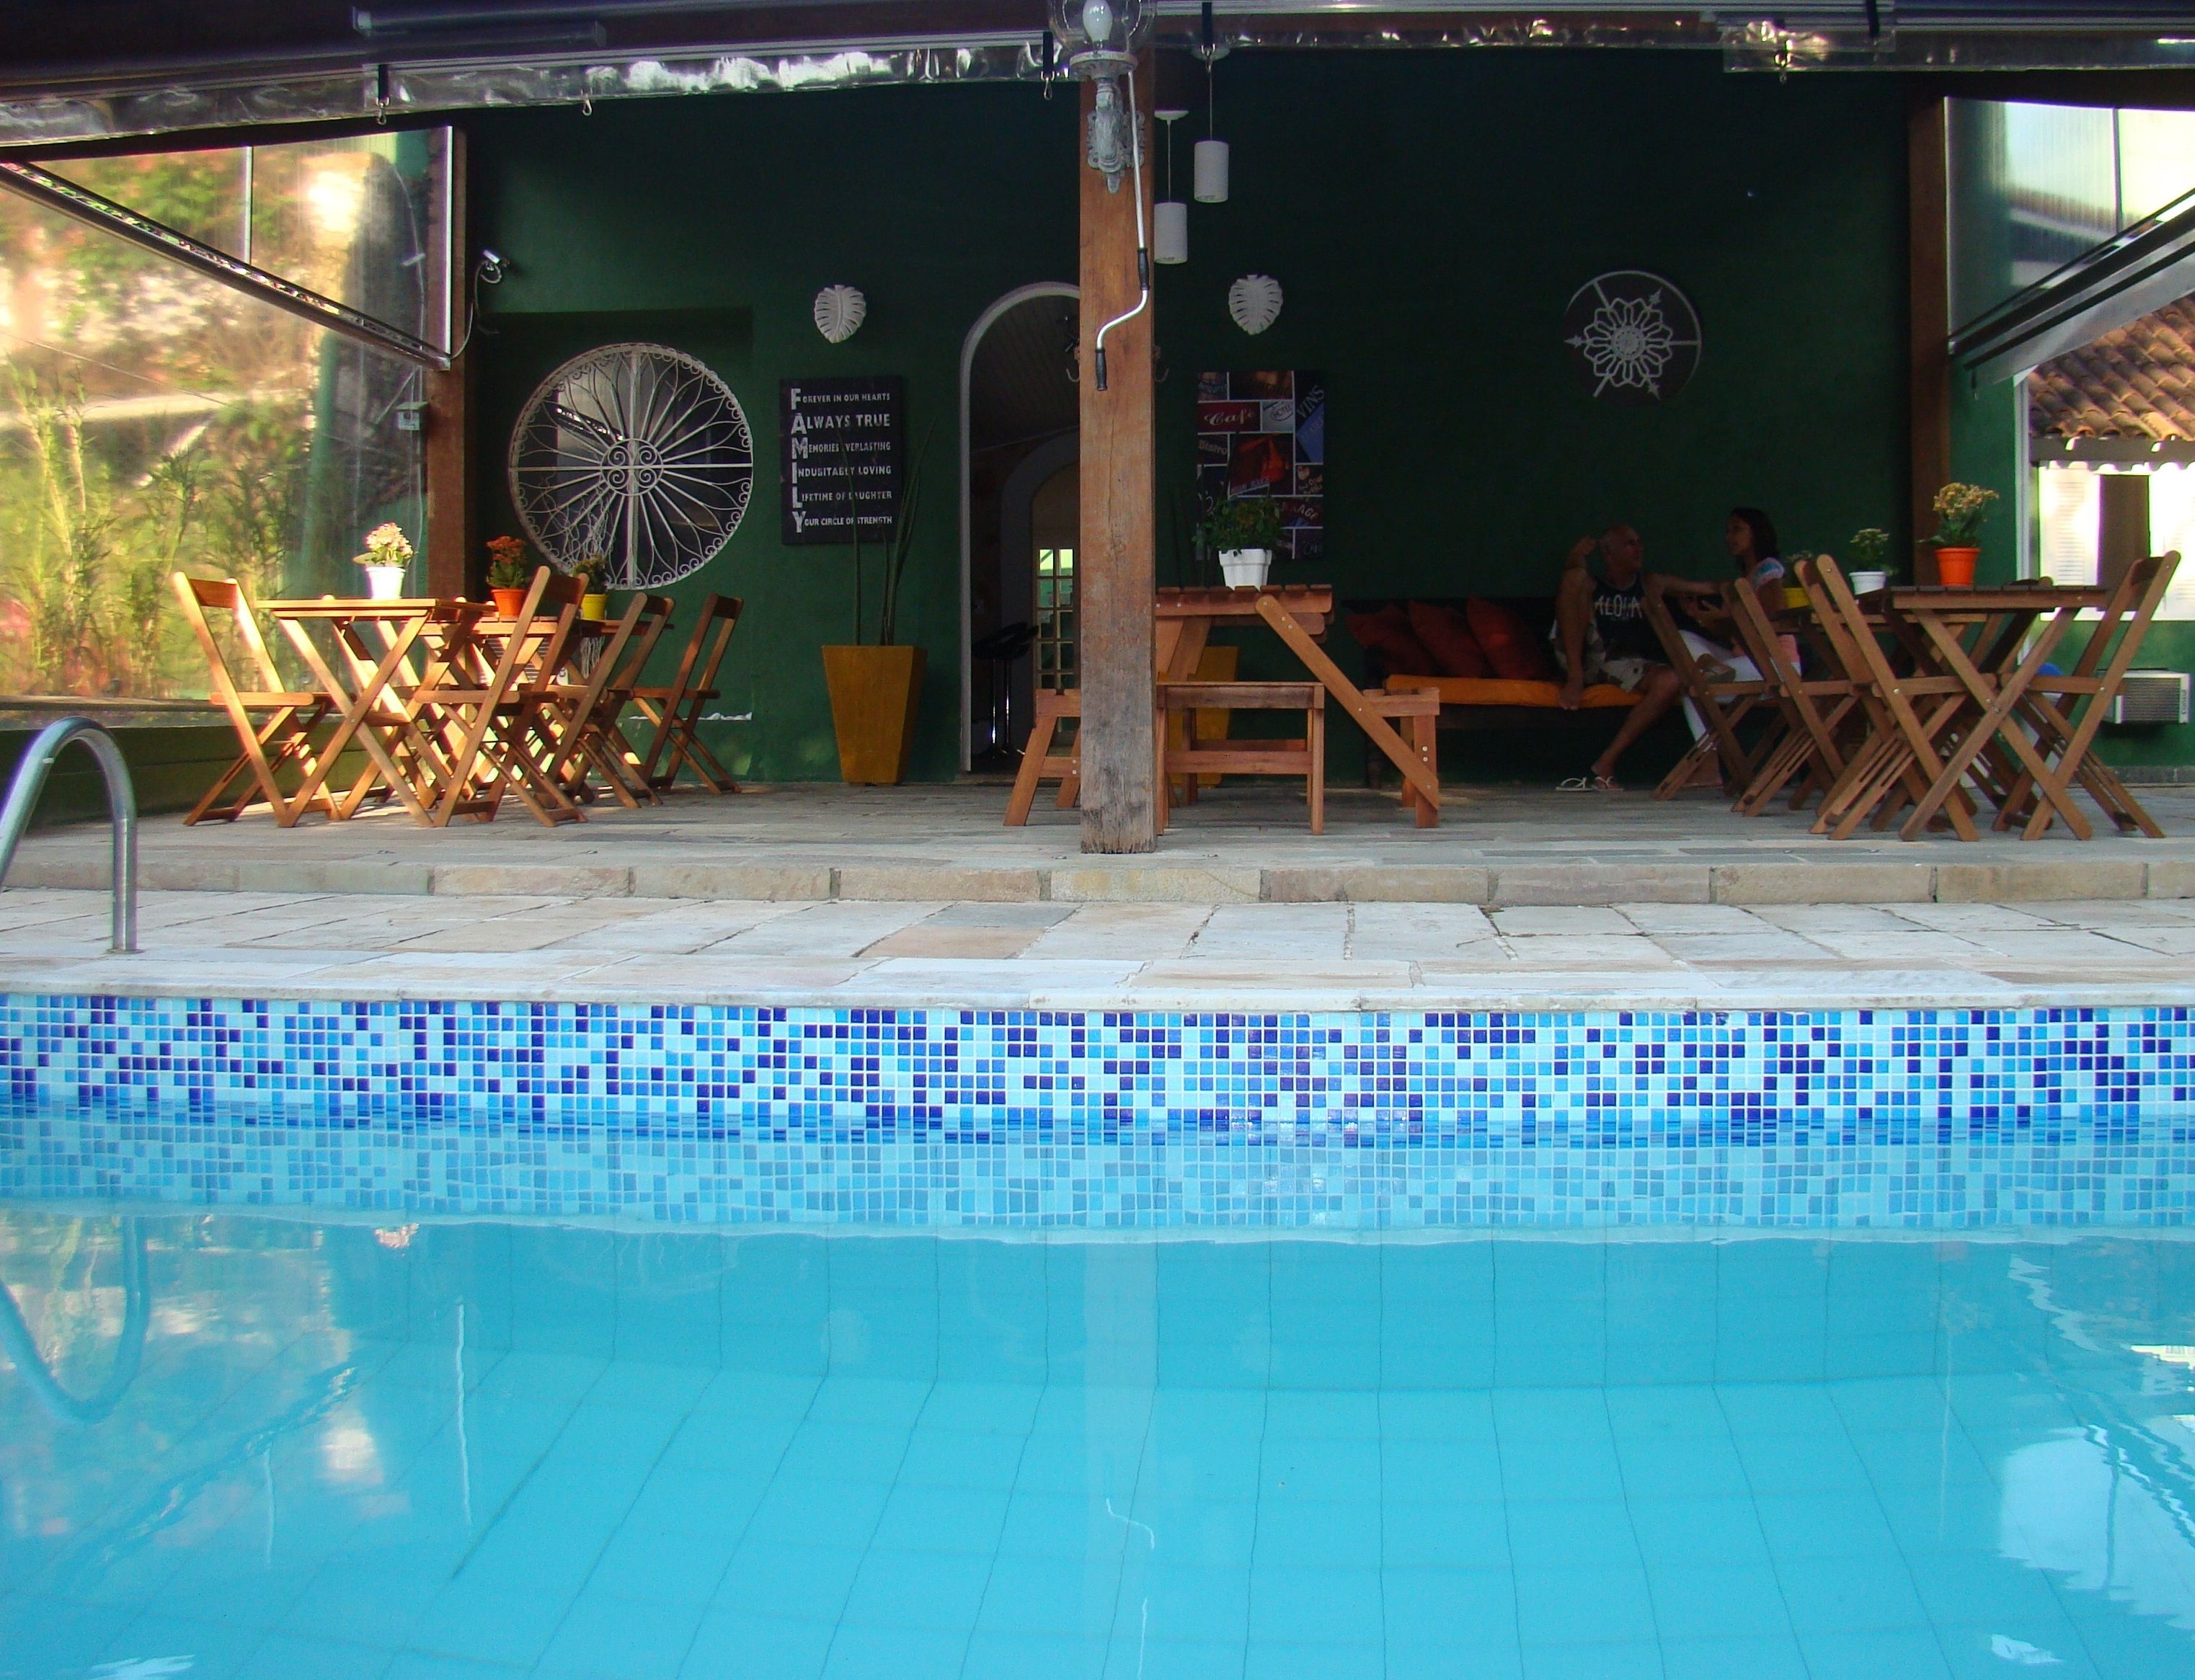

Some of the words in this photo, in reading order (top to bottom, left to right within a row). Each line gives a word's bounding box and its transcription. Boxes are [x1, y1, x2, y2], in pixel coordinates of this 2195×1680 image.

[833, 394, 842, 403] IN
[844, 394, 860, 402] OUR
[862, 393, 891, 402] HEARTS
[1296, 385, 1324, 418] VINS
[856, 413, 891, 427] TRUE
[858, 465, 892, 476] LOVING
[836, 492, 846, 501] OF
[821, 516, 845, 526] CIRCLE
[1593, 594, 1642, 618] ALOHA
